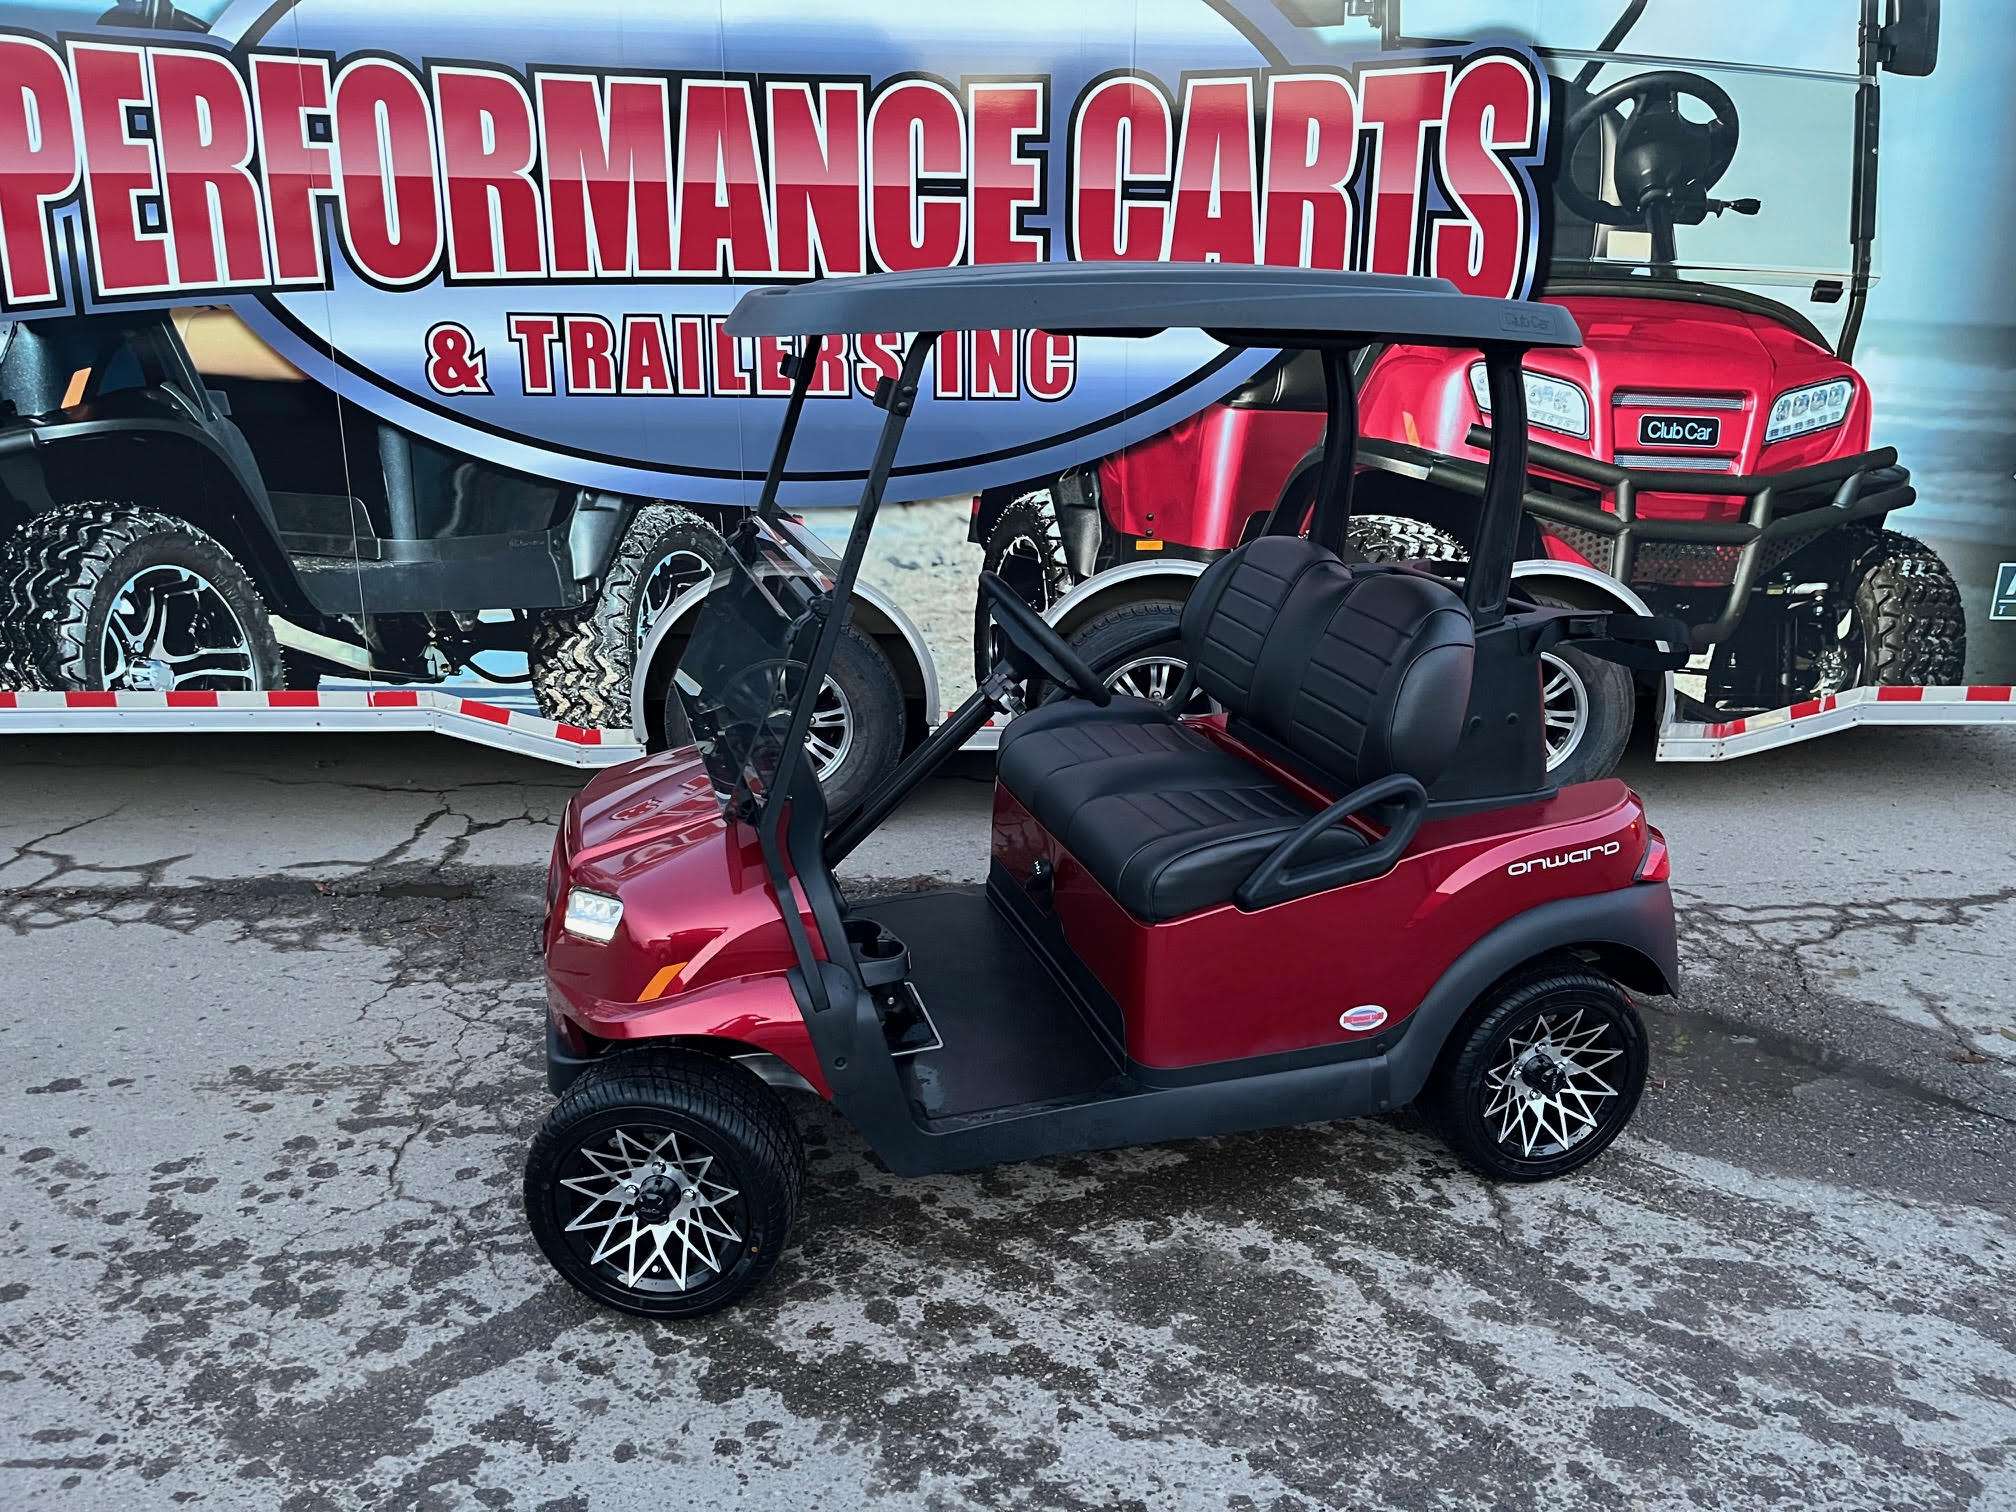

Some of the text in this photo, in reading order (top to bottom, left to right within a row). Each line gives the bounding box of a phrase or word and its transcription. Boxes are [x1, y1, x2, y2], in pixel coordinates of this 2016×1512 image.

[0, 34, 1534, 305] PERFORMANCE CARTS
[428, 315, 1075, 399] & TRAILERS INC
[1647, 421, 1712, 440] Club Car
